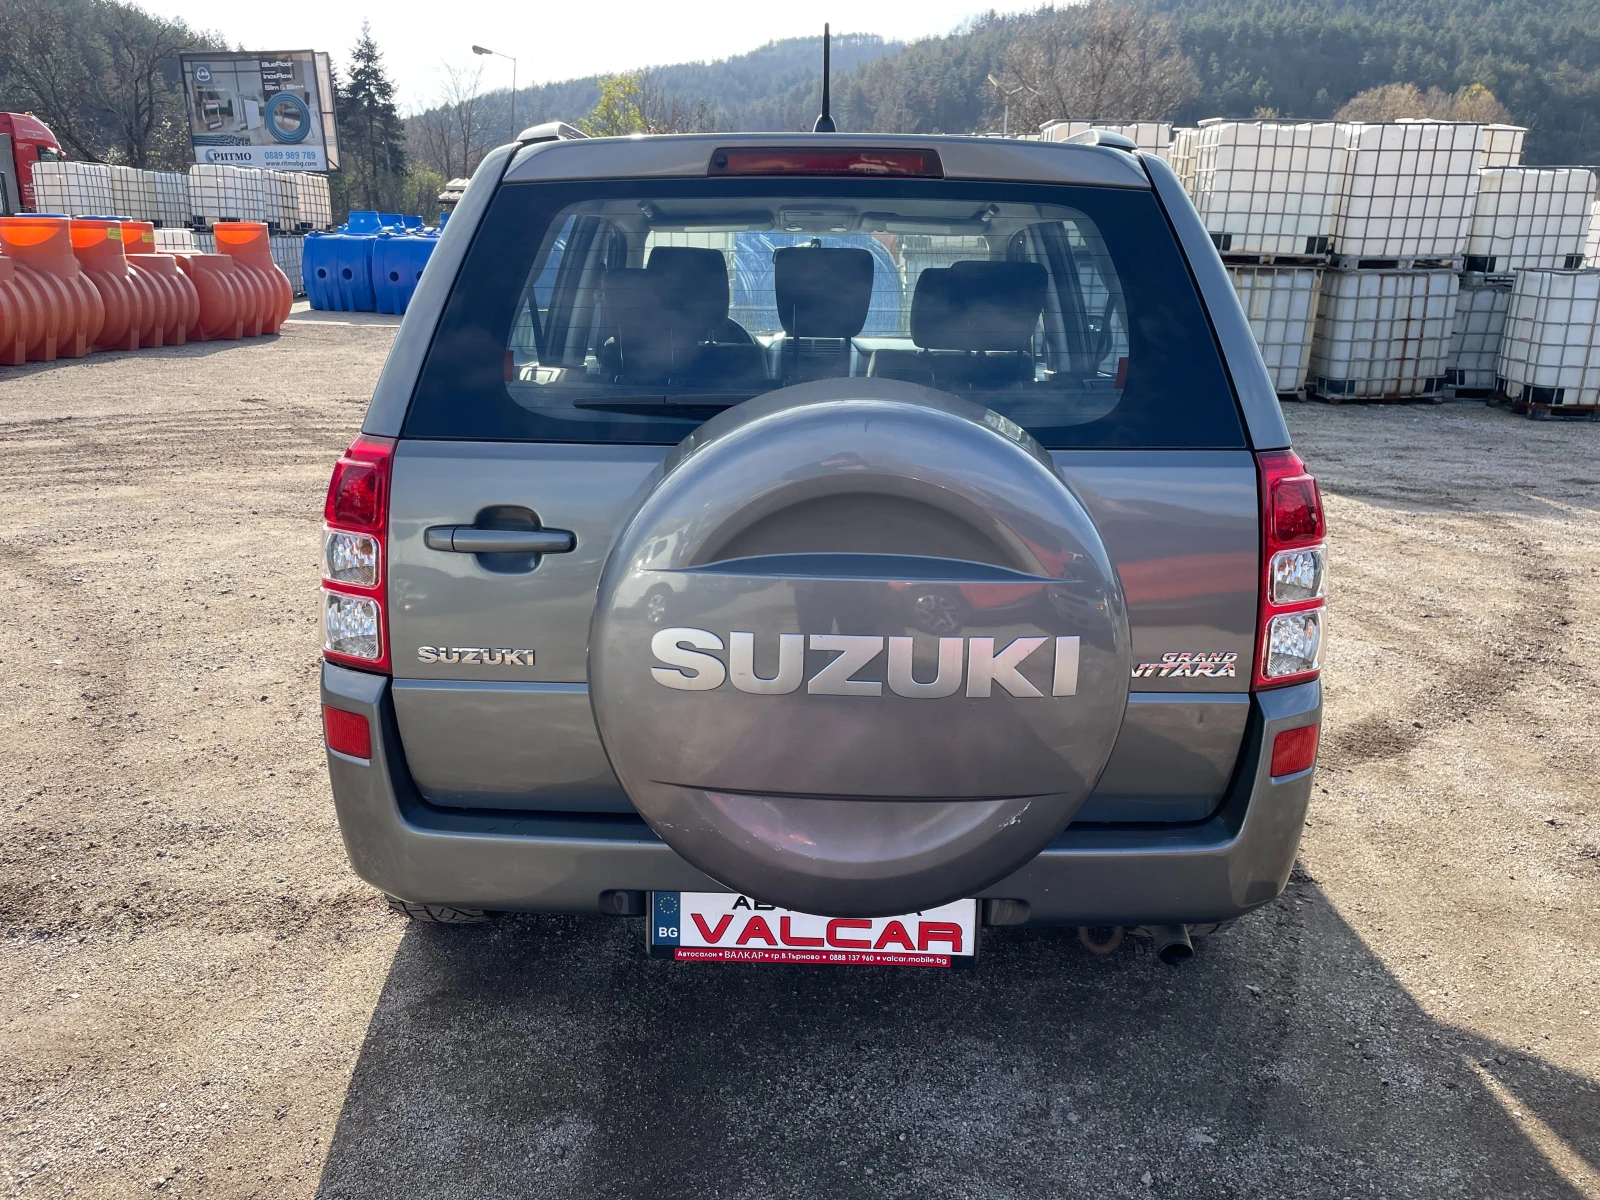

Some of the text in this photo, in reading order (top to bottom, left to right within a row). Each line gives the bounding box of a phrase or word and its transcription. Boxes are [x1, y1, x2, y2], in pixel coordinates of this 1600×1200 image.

[213, 152, 252, 161] РИТМО
[264, 151, 316, 160] 0889 989 789
[417, 645, 536, 666] SUZUKI
[650, 626, 1081, 699] SUZUKI
[1161, 651, 1238, 663] GRAND
[658, 926, 679, 938] BG
[690, 912, 963, 953] VALCAR
[677, 950, 718, 958] Автосалон
[724, 951, 764, 960] ВАЛКАР
[829, 953, 847, 961] 0888
[848, 954, 860, 962] 137
[881, 955, 948, 966] valcar.mobile.bg
